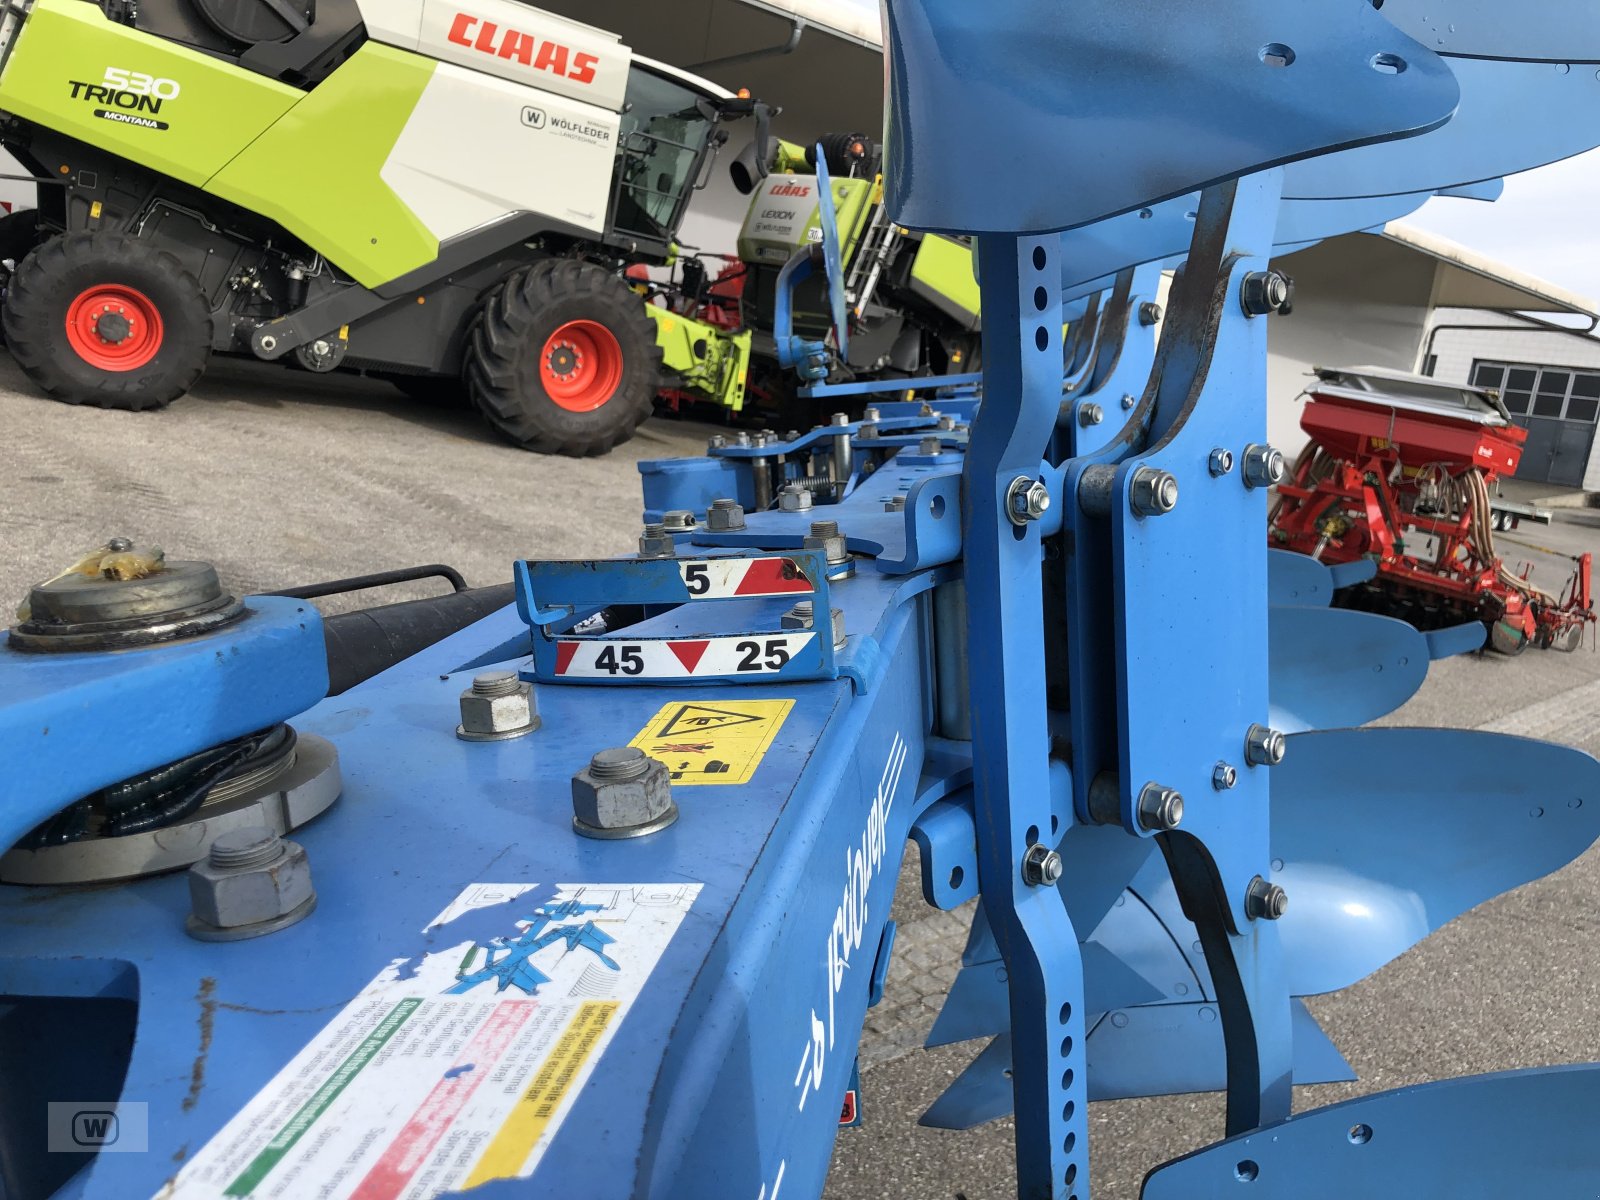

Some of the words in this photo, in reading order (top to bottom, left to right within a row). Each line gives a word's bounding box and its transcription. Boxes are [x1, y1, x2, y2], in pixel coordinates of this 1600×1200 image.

[447, 12, 600, 84] CLAAS
[68, 80, 163, 114] TRION
[101, 66, 180, 100] 530
[104, 111, 158, 128] MONTANA
[527, 110, 540, 124] W
[551, 116, 610, 141] WÖLFLEDER
[768, 185, 811, 198] CLAAS
[761, 209, 796, 221] LEXION
[594, 645, 645, 676] 45
[735, 639, 790, 671] 25
[490, 1064, 514, 1081] breit
[502, 1065, 533, 1093] schmal
[533, 1104, 556, 1117] mit
[344, 1127, 386, 1162] Spindel
[430, 1129, 468, 1165] Spindel
[451, 1131, 488, 1166] Spindel
